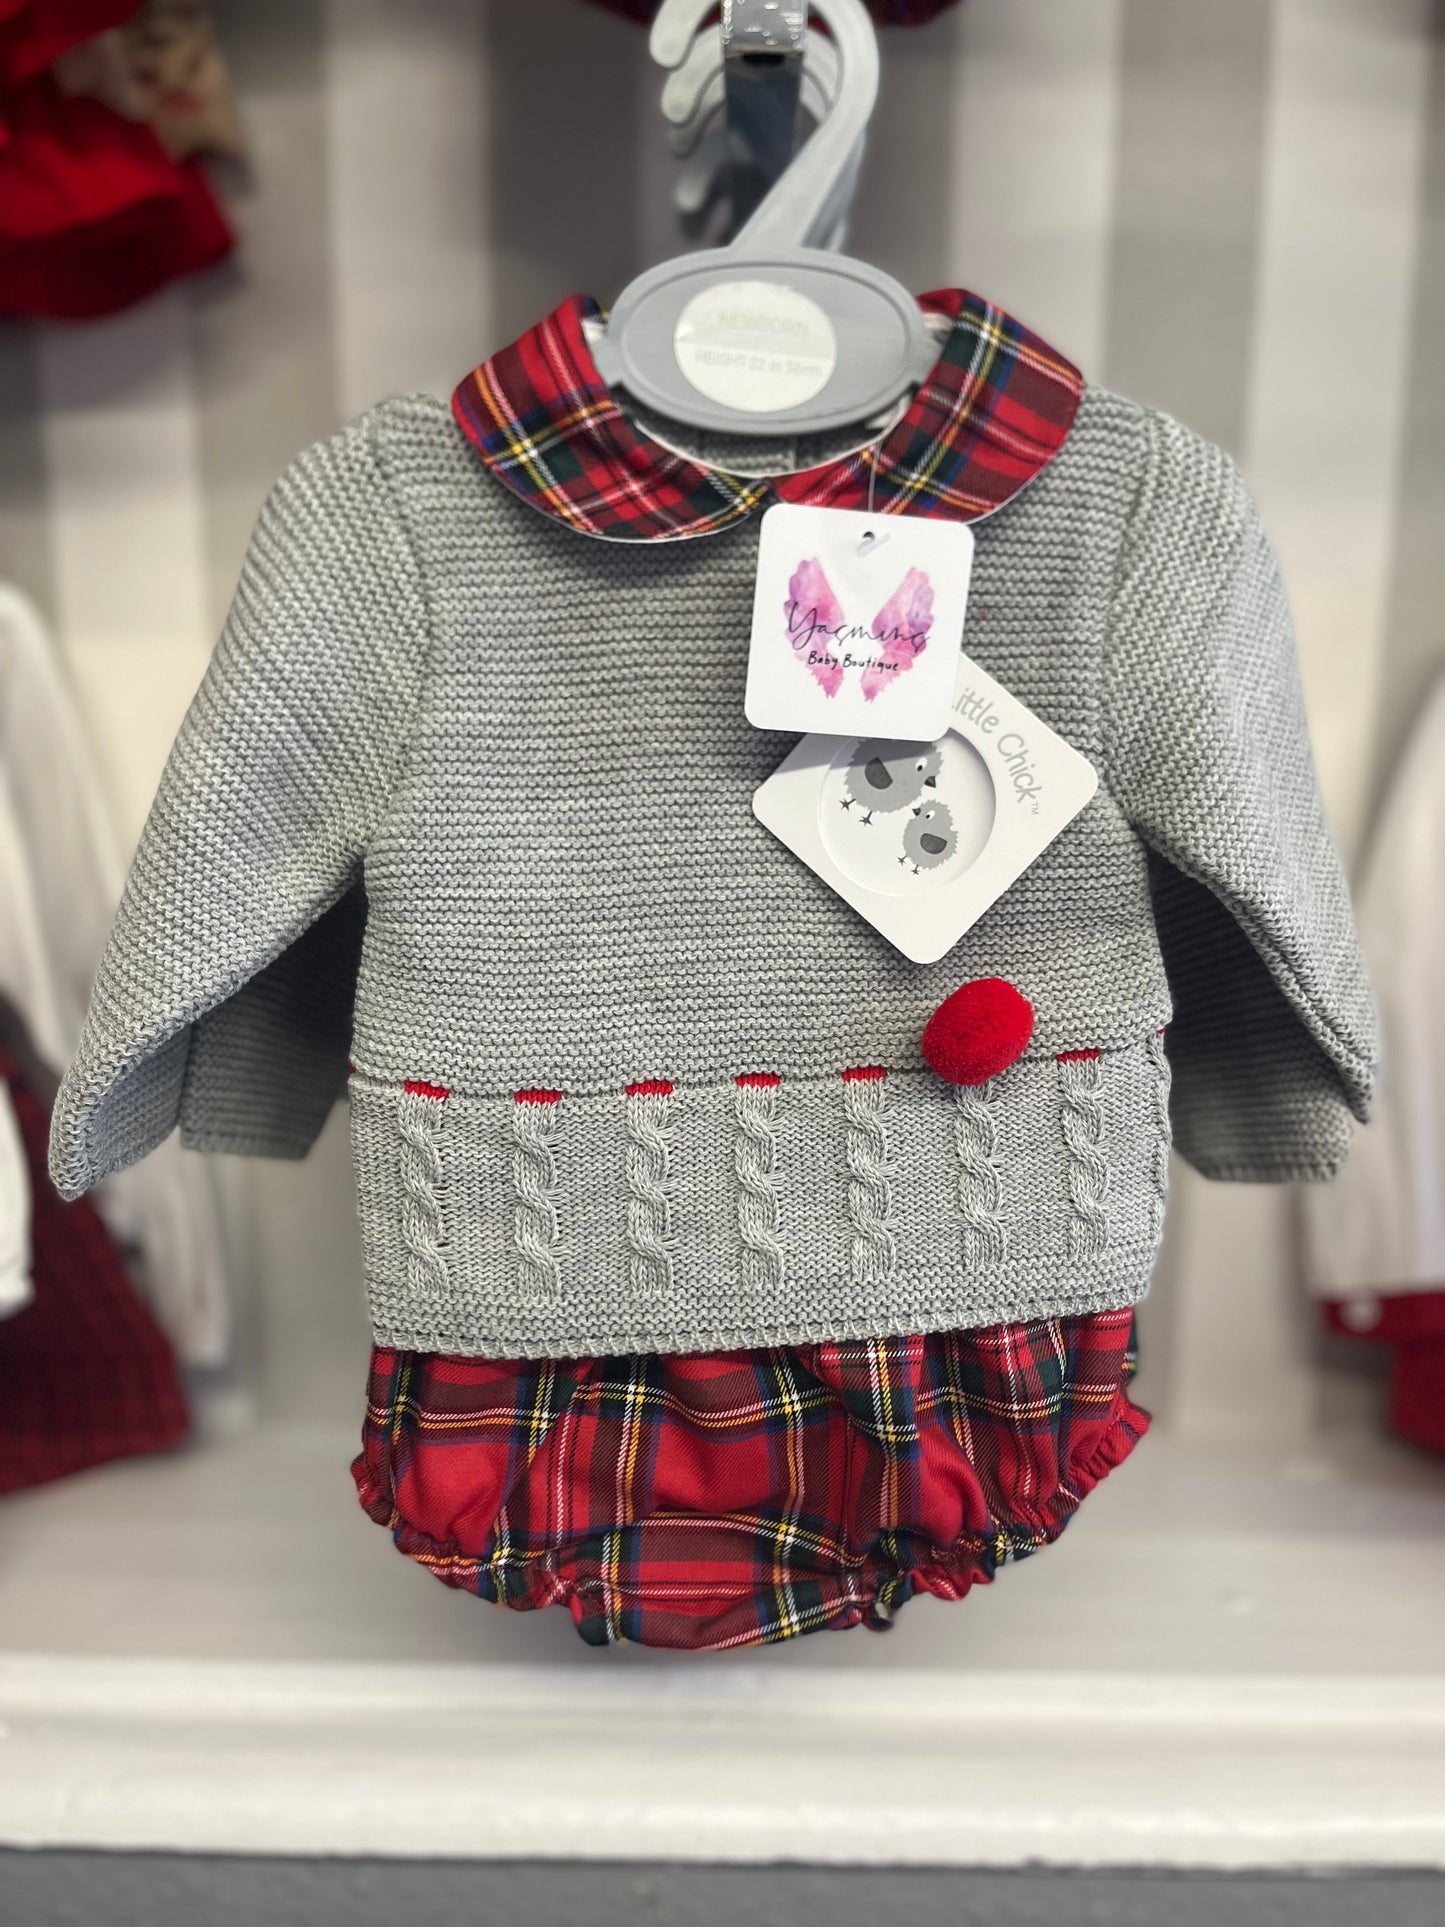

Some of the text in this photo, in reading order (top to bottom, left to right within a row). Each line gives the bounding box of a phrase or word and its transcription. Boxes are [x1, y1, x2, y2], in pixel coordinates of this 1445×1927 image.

[807, 650, 899, 674] Baby Boutique
[951, 687, 1000, 734] ittle
